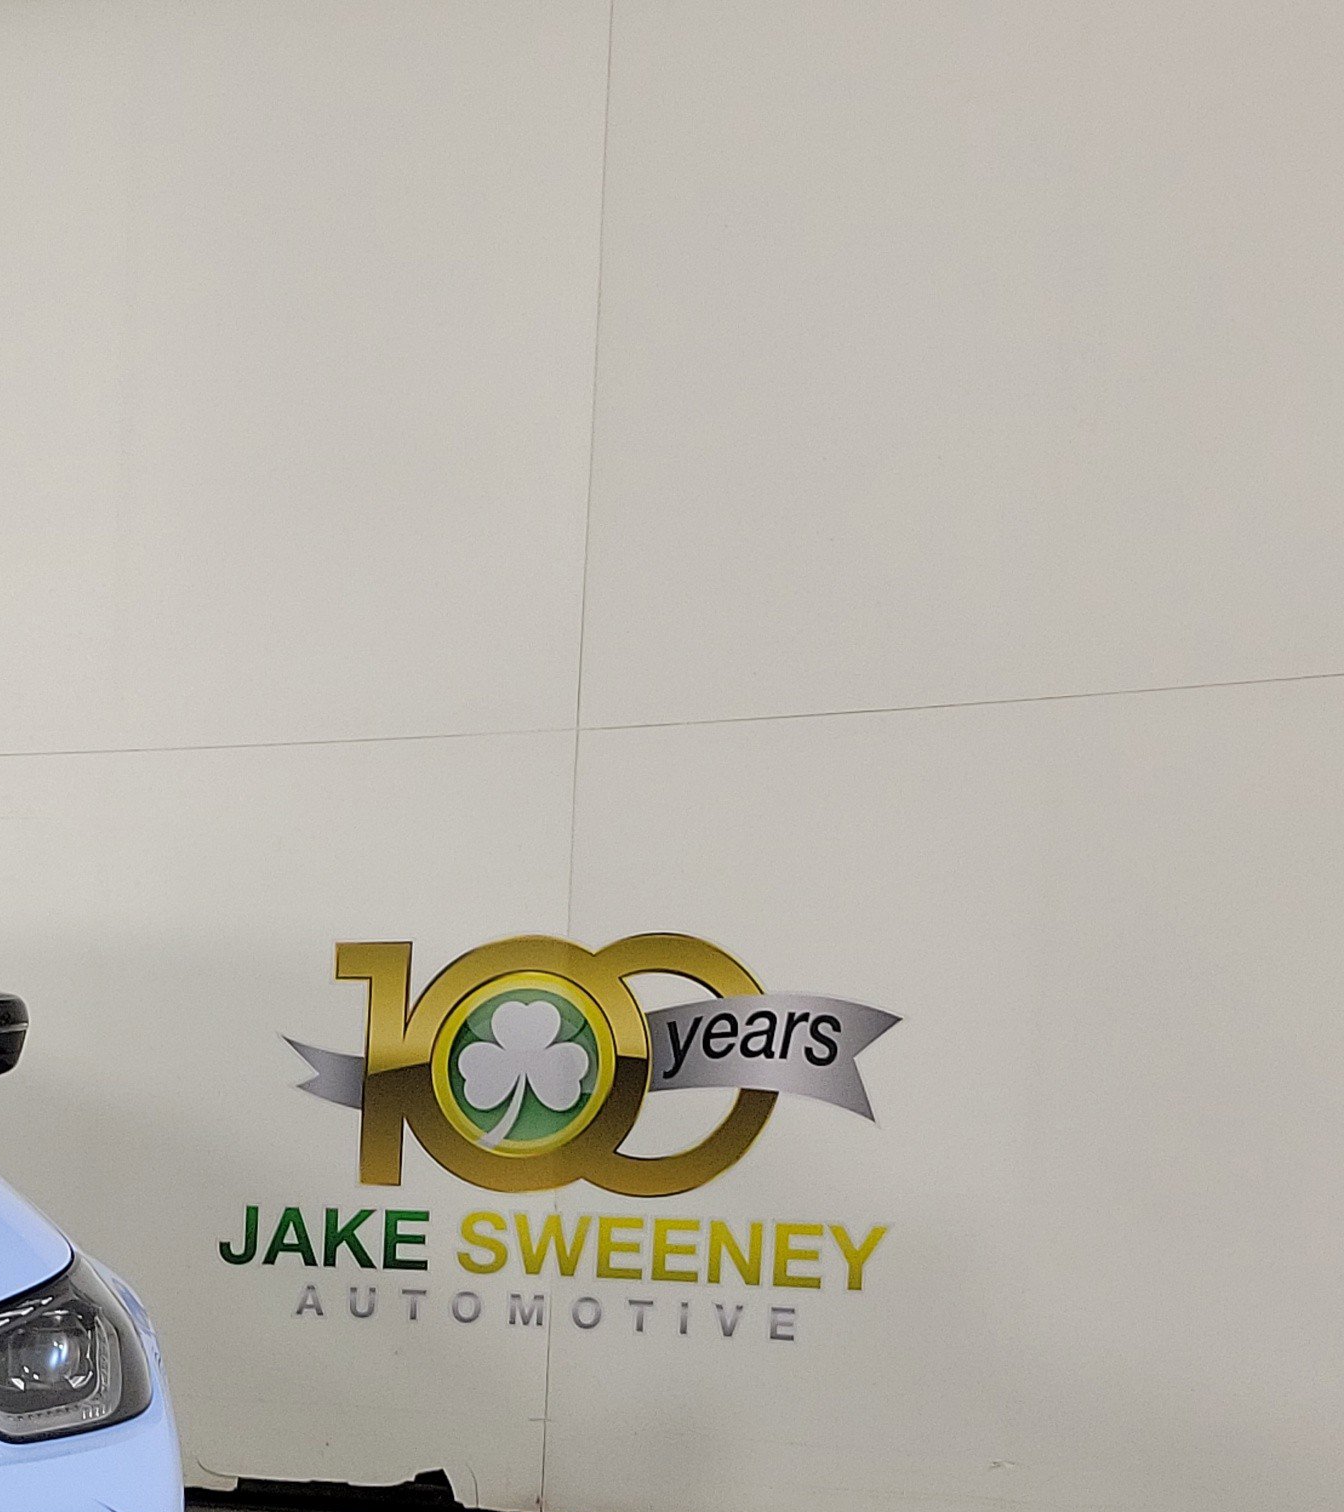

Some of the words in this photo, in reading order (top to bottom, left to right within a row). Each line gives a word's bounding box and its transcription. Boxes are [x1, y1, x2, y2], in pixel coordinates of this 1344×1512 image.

[335, 932, 780, 1197] 100
[662, 1007, 843, 1079] years
[217, 1204, 431, 1271] JAKE
[456, 1210, 888, 1292] SWEENEY
[294, 1284, 799, 1342] AUTOMOTIVE
